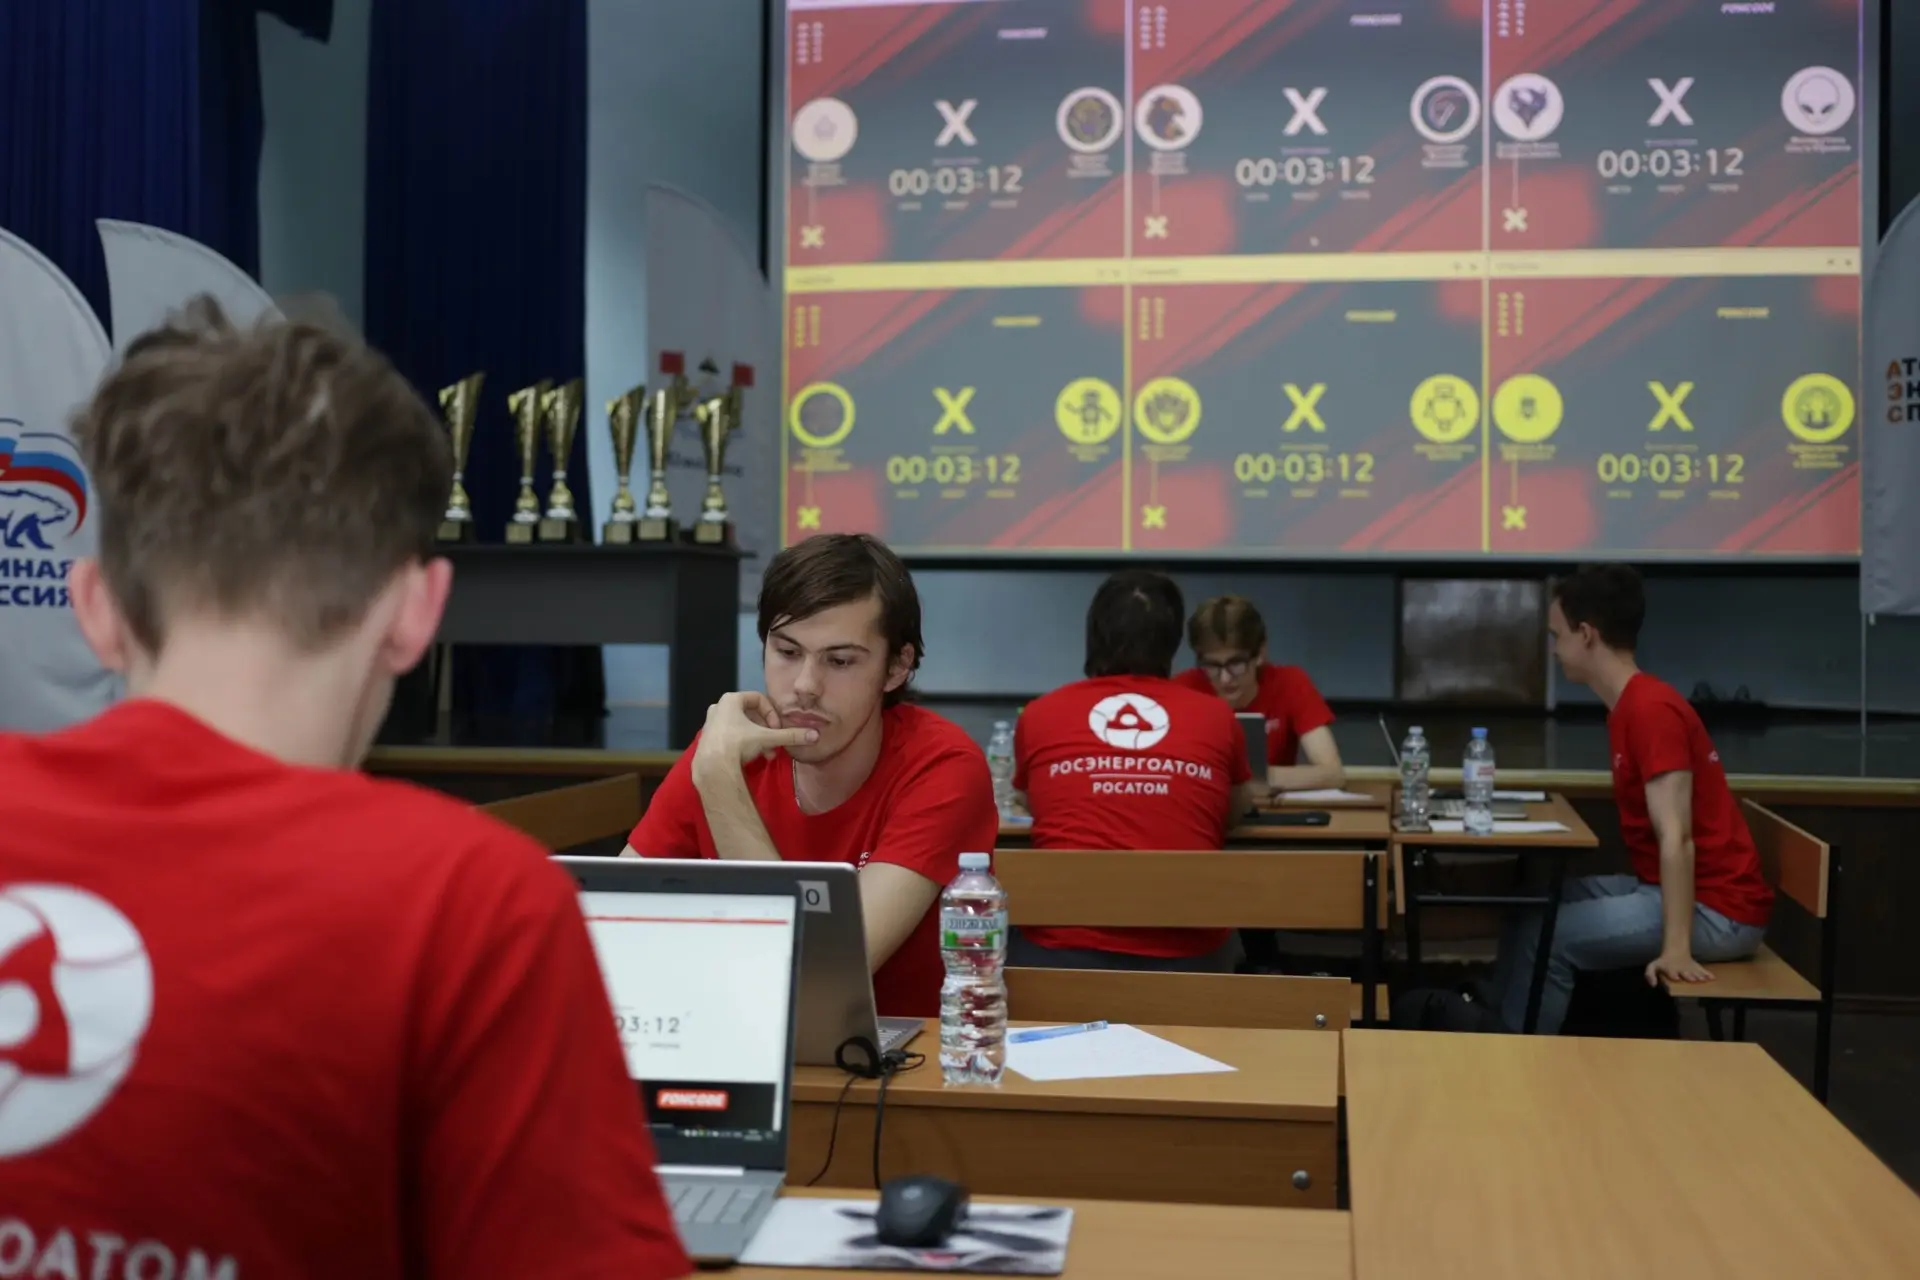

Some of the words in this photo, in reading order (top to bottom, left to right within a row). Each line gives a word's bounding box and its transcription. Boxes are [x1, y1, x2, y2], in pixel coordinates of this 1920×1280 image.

[1235, 155, 1375, 186] 00:03:12
[1597, 147, 1744, 178] 00:03:12
[889, 165, 1022, 196] 00:03:12
[1887, 357, 1920, 378] АТ
[887, 455, 1020, 483] 00:03:12
[1234, 453, 1374, 482] 00:03:12
[1597, 453, 1744, 483] 00:03:12
[1049, 756, 1213, 781] РОСЭНЕРГОАТОМ
[1092, 781, 1169, 795] РОСАТОМ
